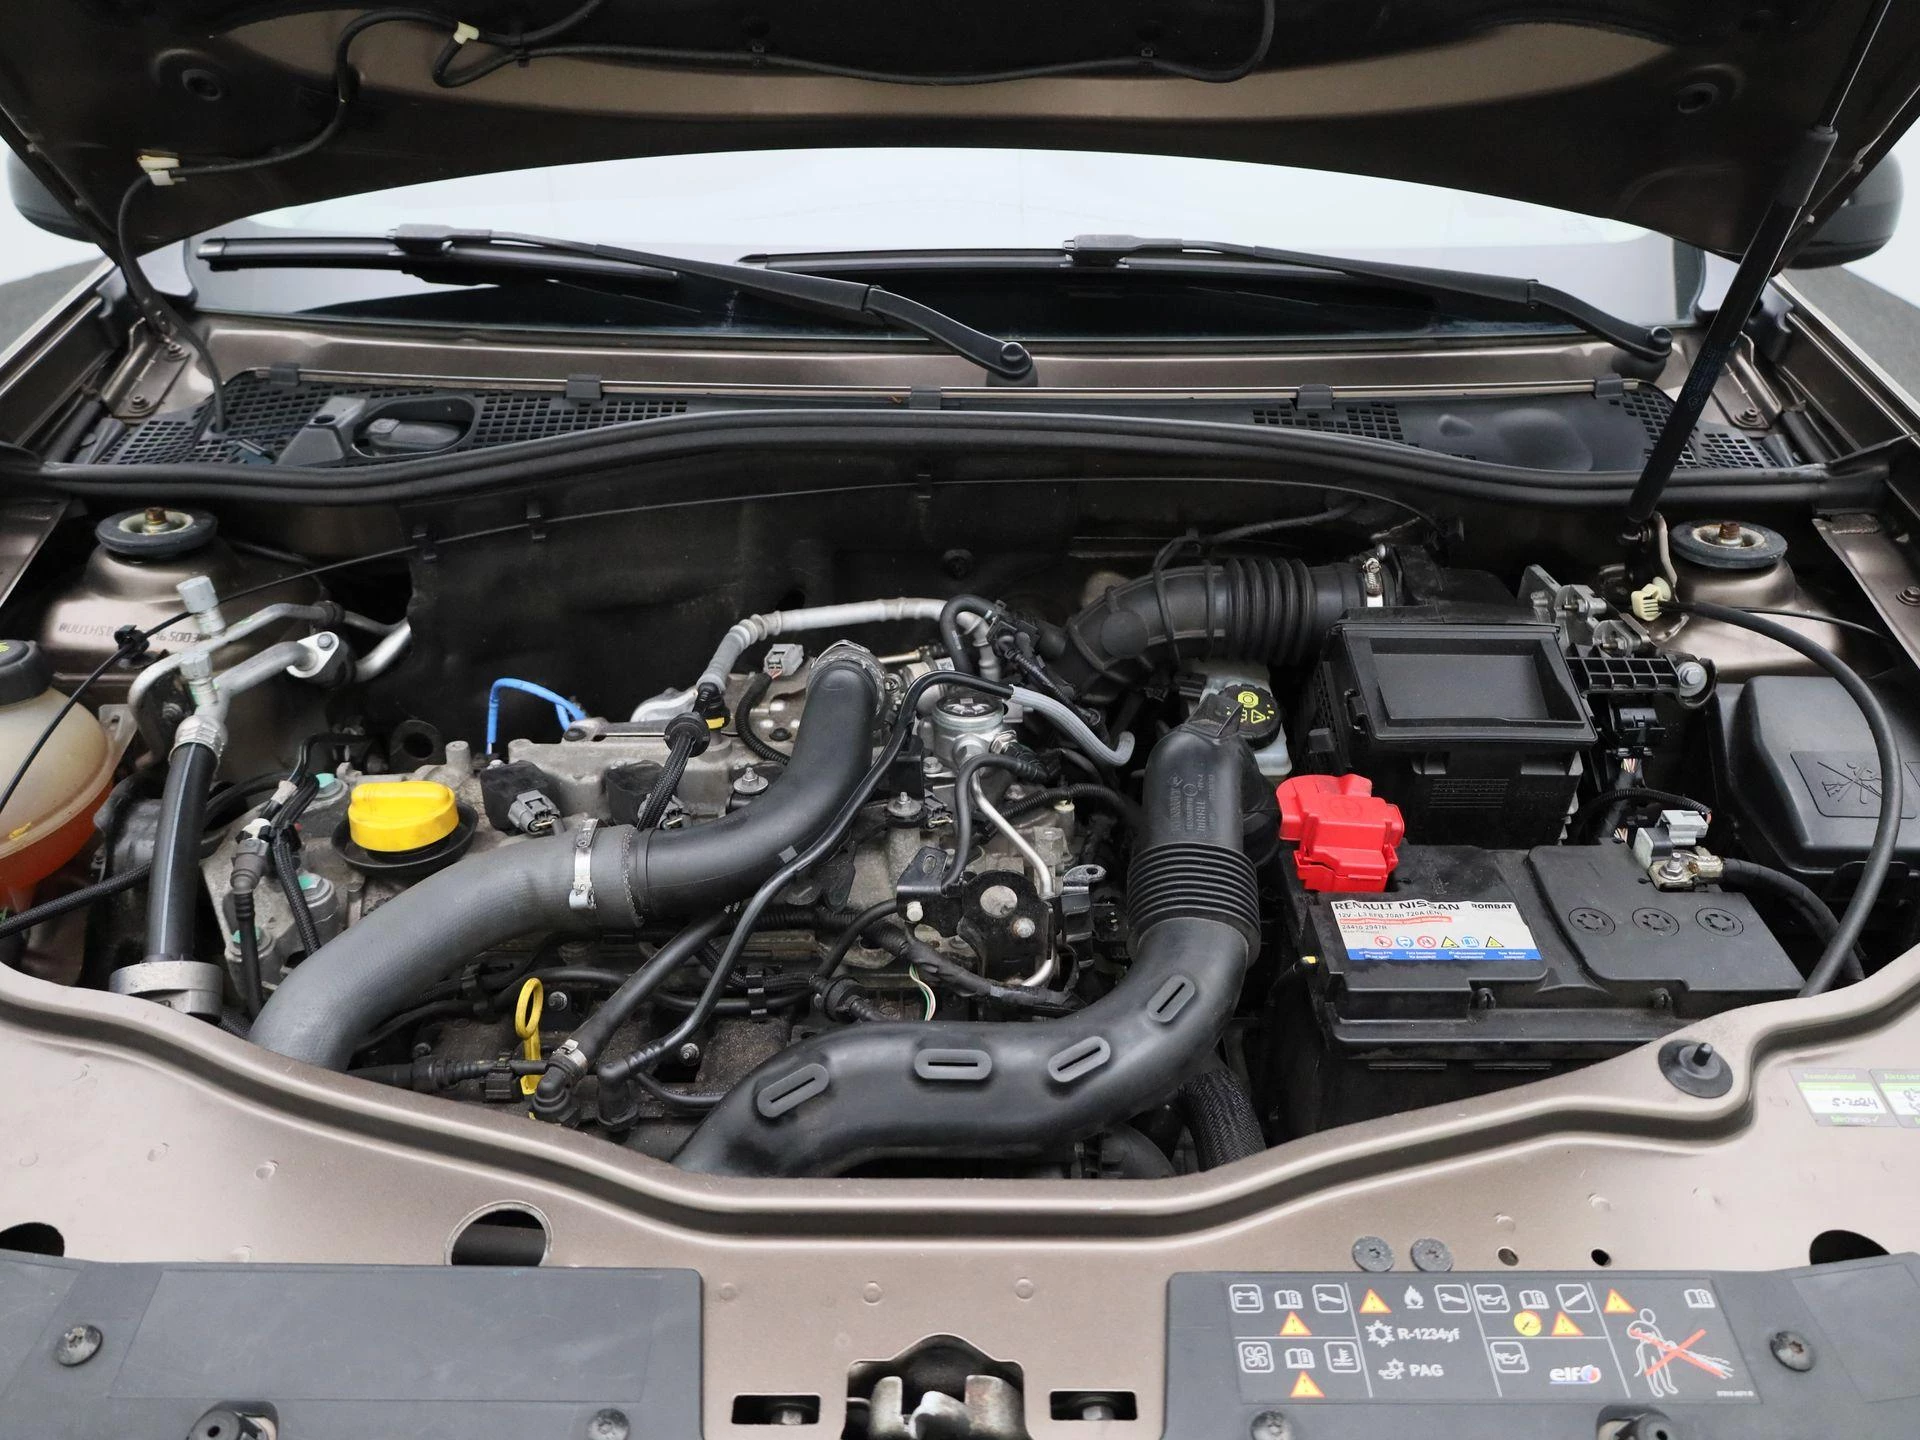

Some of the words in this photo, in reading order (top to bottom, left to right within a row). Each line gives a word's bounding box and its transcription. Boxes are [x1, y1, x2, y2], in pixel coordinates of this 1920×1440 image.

[1334, 901, 1394, 910] RENAULT
[1399, 900, 1460, 910] NISSAN
[1396, 1327, 1460, 1343] R-1234yf
[1408, 1364, 1445, 1377] PAG
[1549, 1366, 1581, 1381] elf
